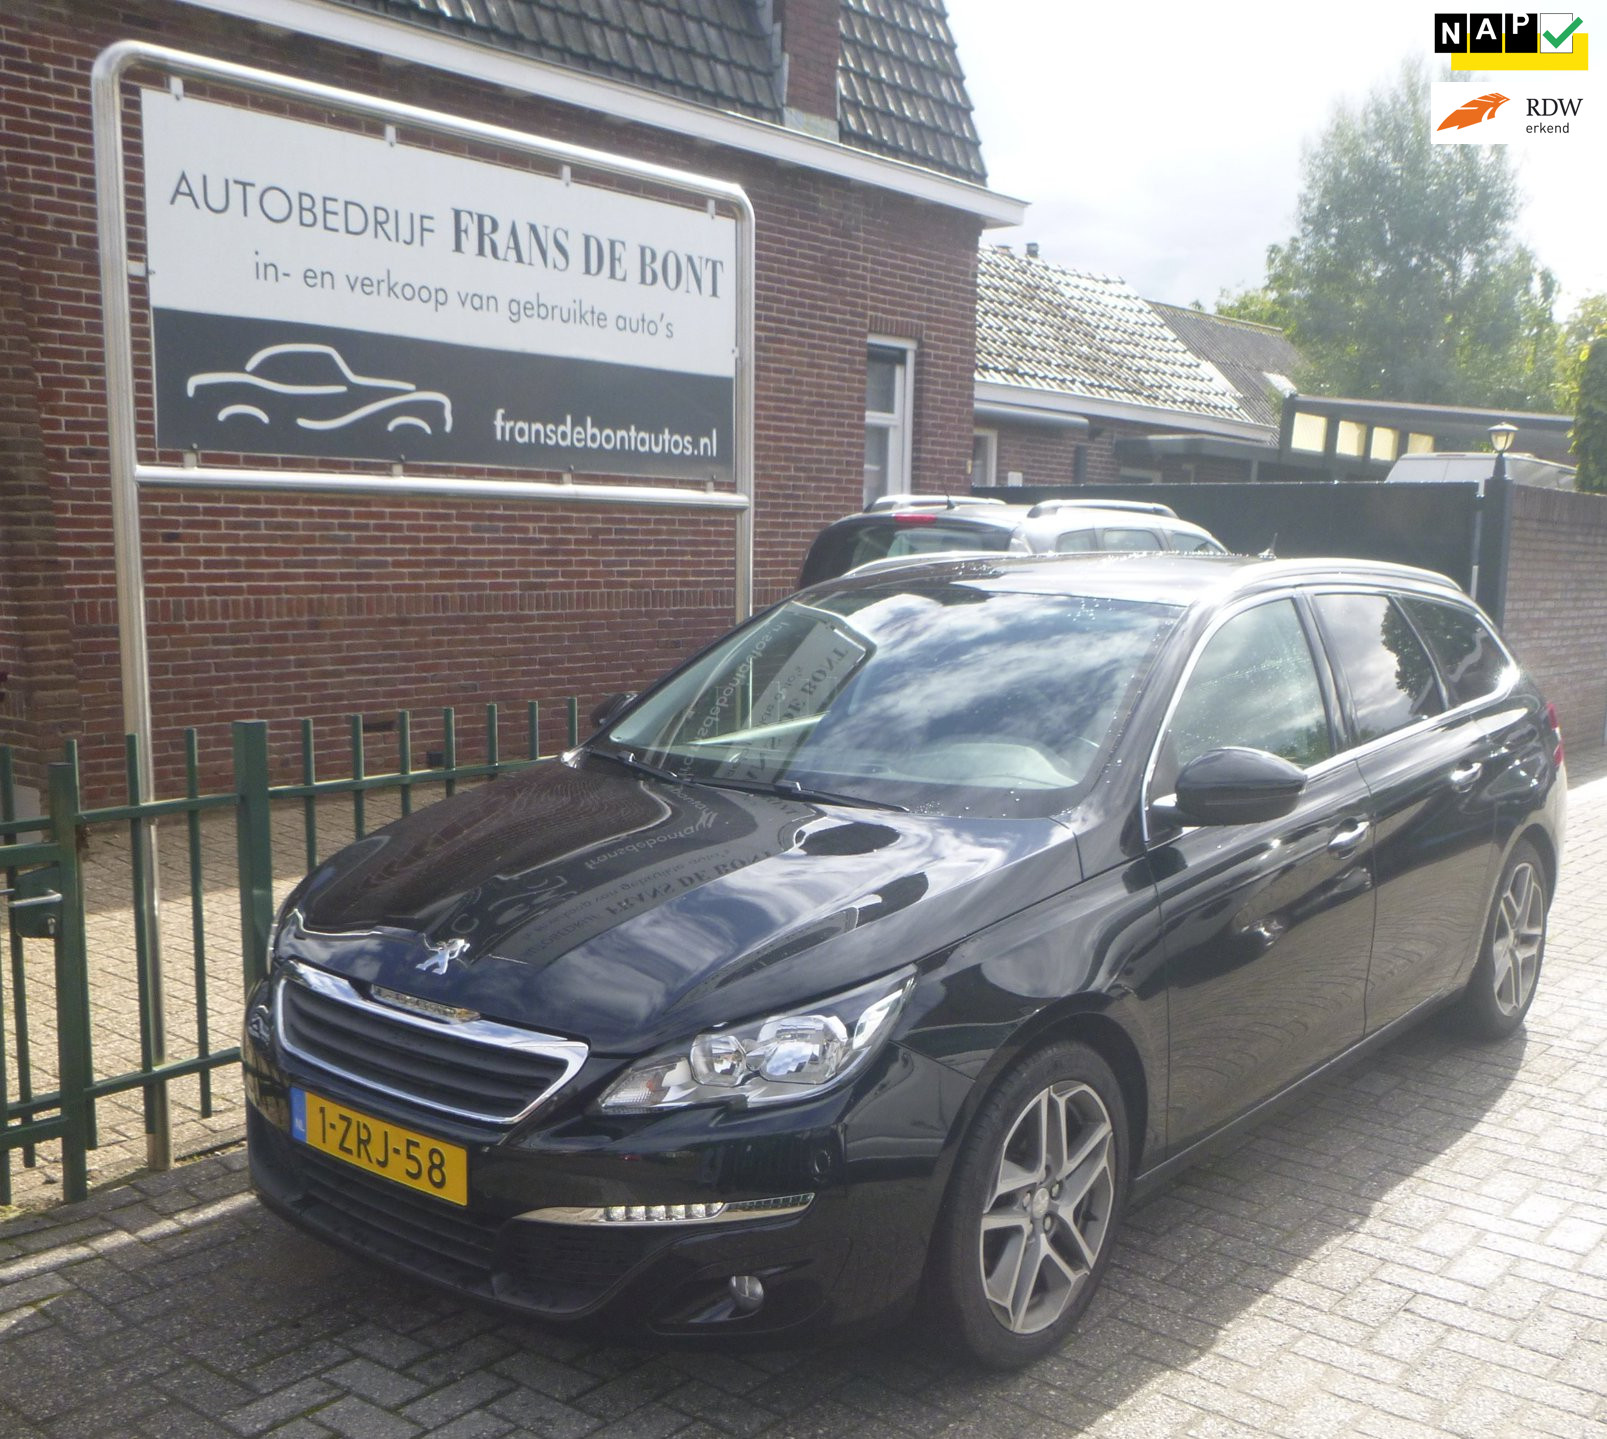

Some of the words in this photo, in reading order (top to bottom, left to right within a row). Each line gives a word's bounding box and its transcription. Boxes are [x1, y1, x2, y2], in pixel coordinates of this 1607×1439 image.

[169, 170, 436, 247] AUTOBEDRIJF
[451, 207, 570, 272] FRANS
[582, 233, 627, 282] DE
[638, 244, 724, 299] BONT
[254, 250, 291, 283] in-
[303, 268, 335, 290] en
[345, 269, 448, 312] verkoop
[457, 290, 498, 313] van
[508, 292, 607, 329] gebruikte
[615, 313, 674, 339] auto's
[494, 408, 717, 457] fransdebontautos.nl
[319, 1106, 446, 1189] 1-ZRJ-58
